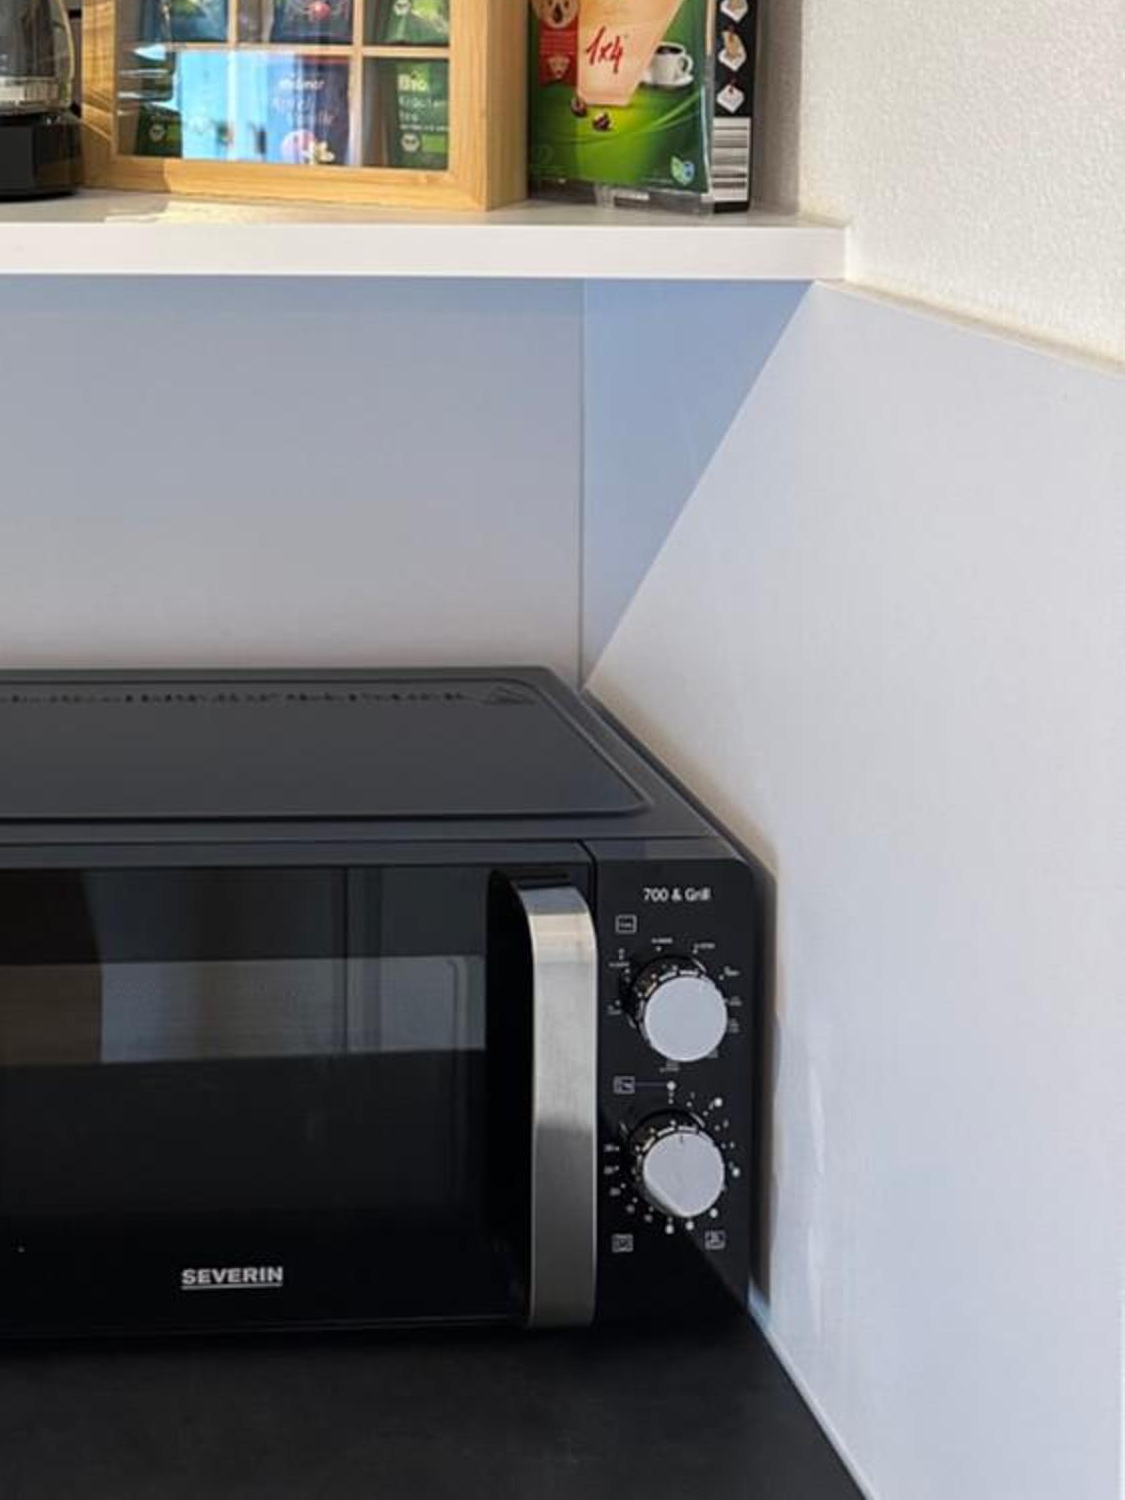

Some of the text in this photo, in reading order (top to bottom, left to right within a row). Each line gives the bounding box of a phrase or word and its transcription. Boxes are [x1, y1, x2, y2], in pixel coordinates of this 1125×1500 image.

[585, 25, 623, 75] 1x4
[643, 887, 711, 902] 700 & Grill
[181, 1266, 283, 1285] SEVERIN
